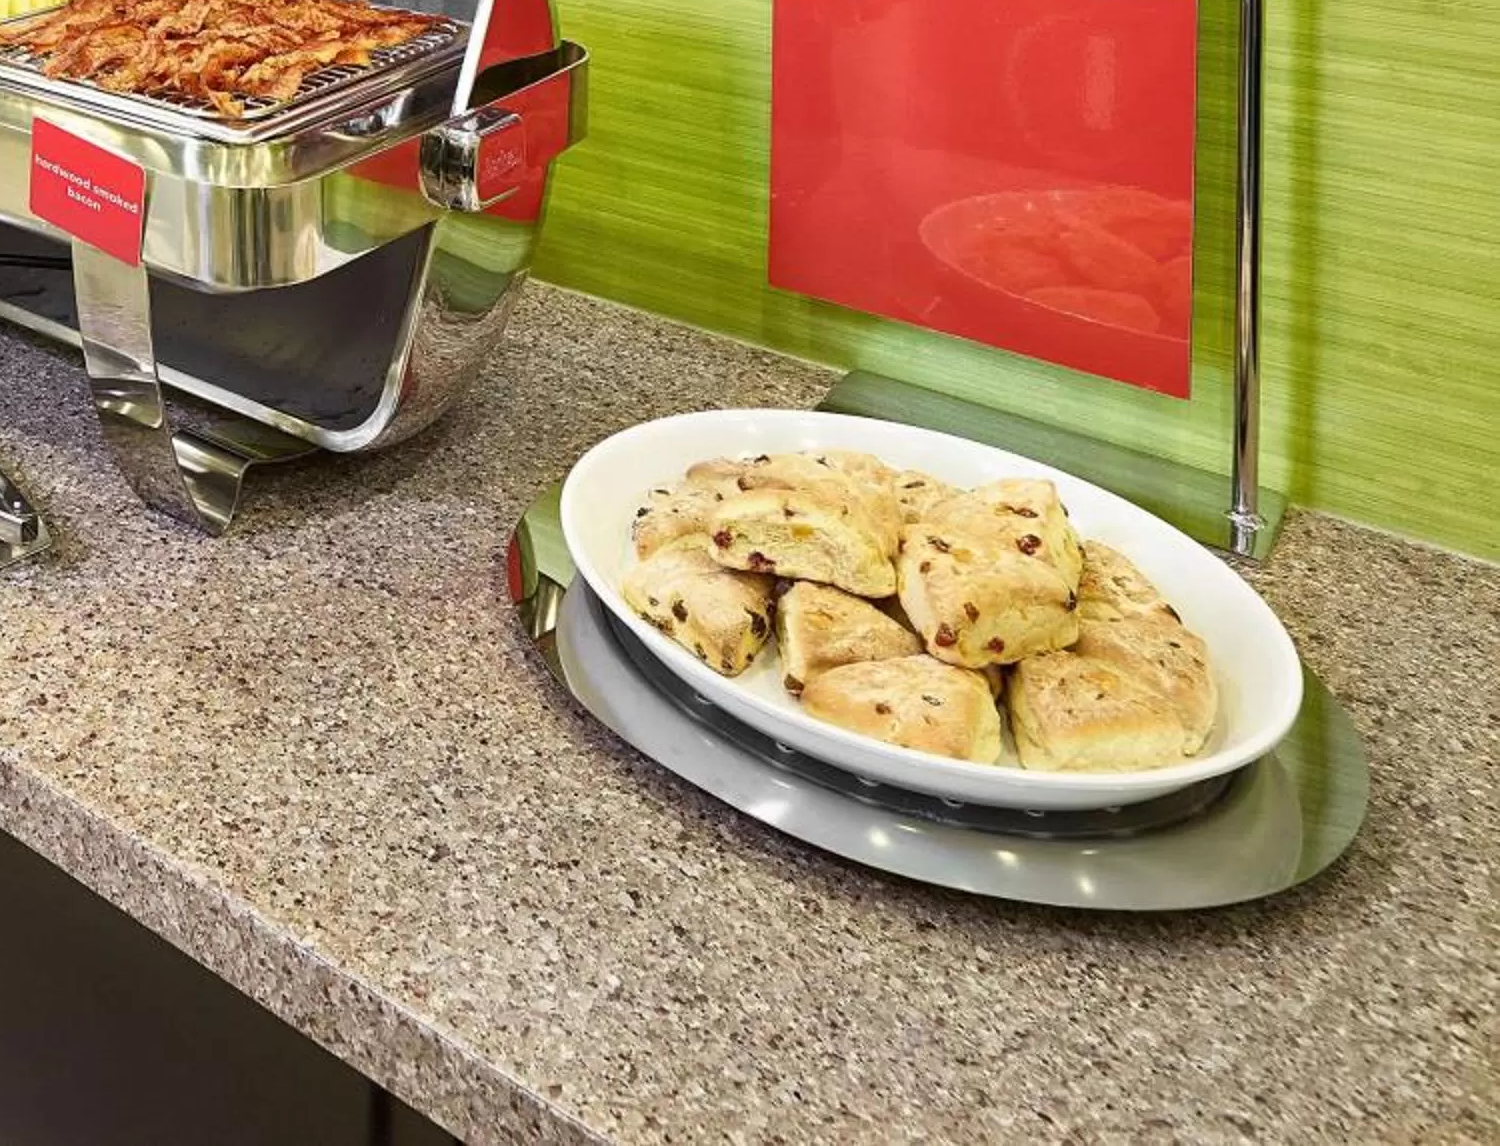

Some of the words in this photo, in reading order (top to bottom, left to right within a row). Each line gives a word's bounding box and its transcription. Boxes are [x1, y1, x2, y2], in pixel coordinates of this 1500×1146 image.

[35, 153, 91, 190] hardwood
[93, 185, 139, 213] smoked
[67, 185, 101, 212] bacon
